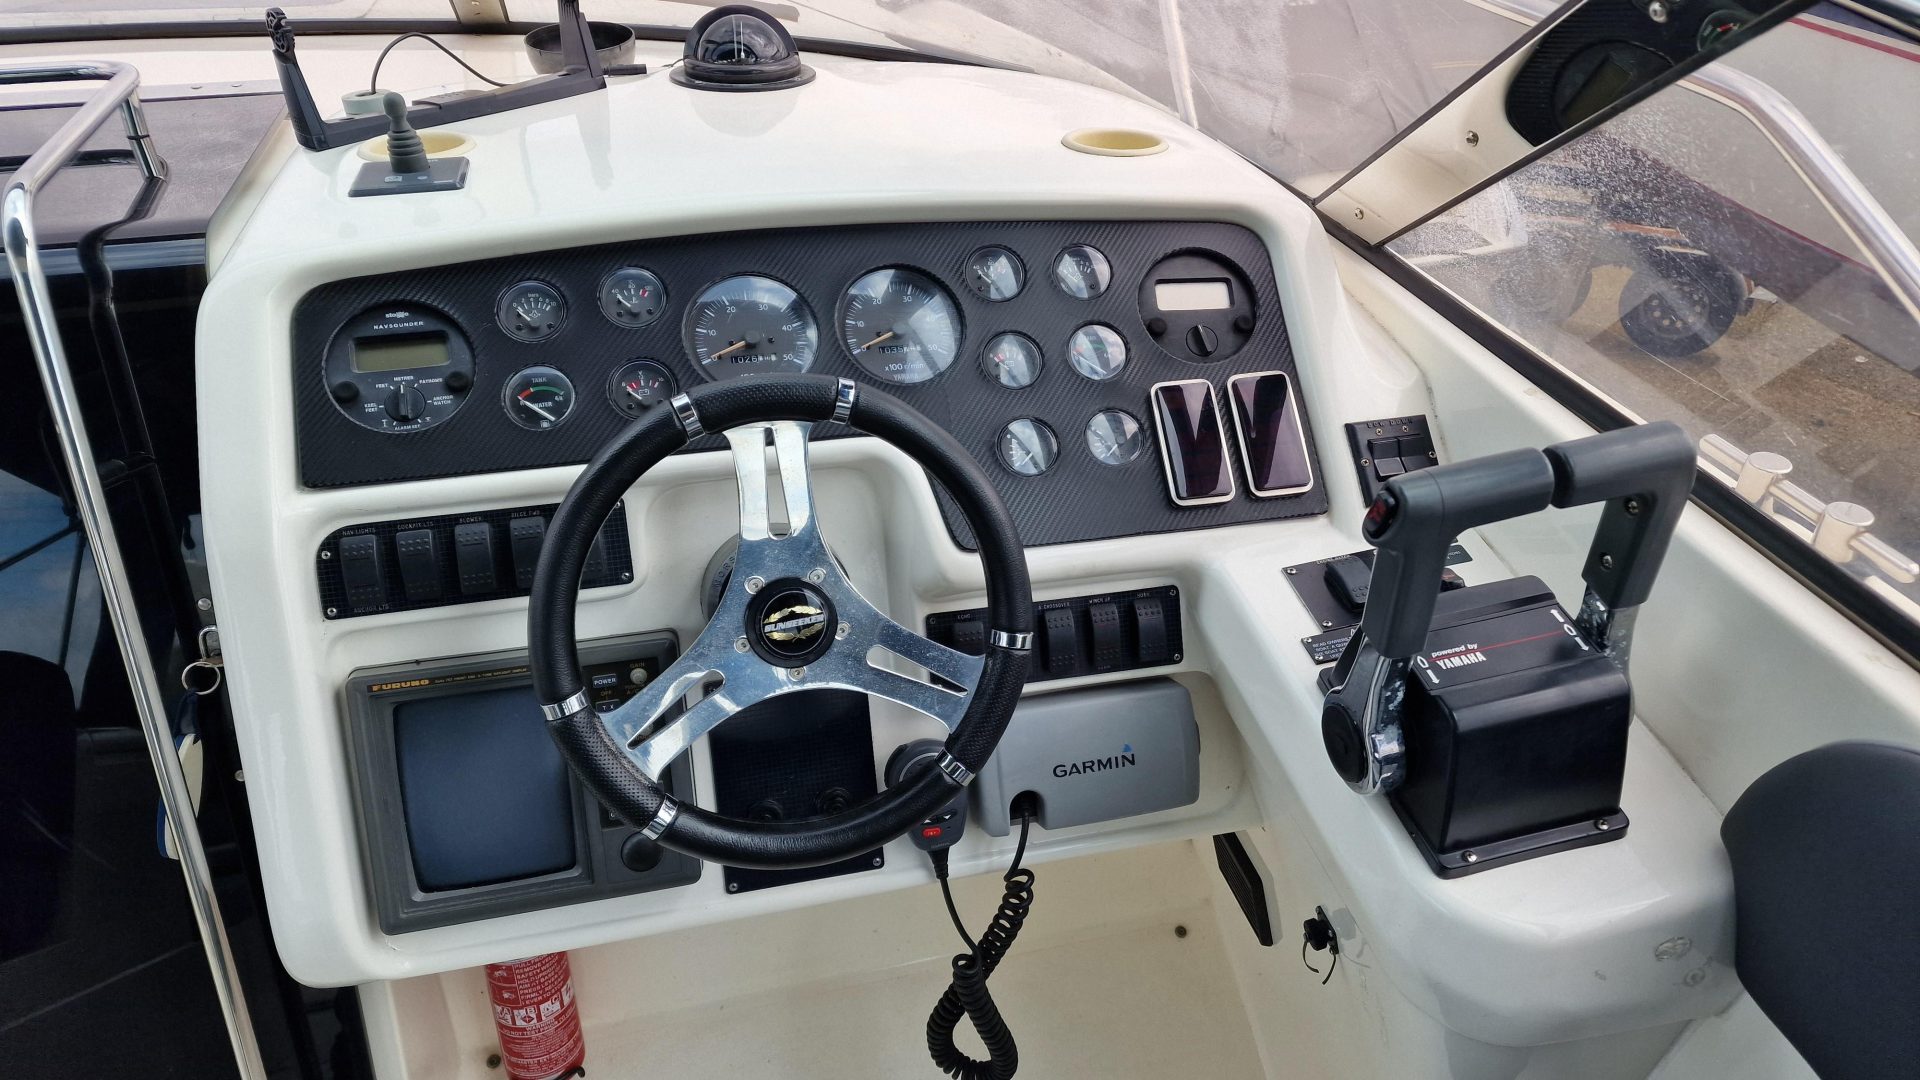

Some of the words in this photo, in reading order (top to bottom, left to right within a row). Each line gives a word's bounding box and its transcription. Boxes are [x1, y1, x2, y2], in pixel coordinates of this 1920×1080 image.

[902, 295, 912, 303] 30
[726, 305, 736, 313] 20
[758, 303, 768, 311] 30
[373, 321, 424, 330] NAVSOUNDER
[781, 324, 792, 332] 40
[857, 320, 865, 328] 10
[783, 353, 793, 361] 50
[1431, 644, 1465, 658] powered
[1467, 643, 1478, 651] by
[1436, 652, 1487, 670] YAMAHA
[371, 679, 430, 692] FURUNO
[594, 677, 616, 686] POWER
[1053, 753, 1135, 777] GARMIN
